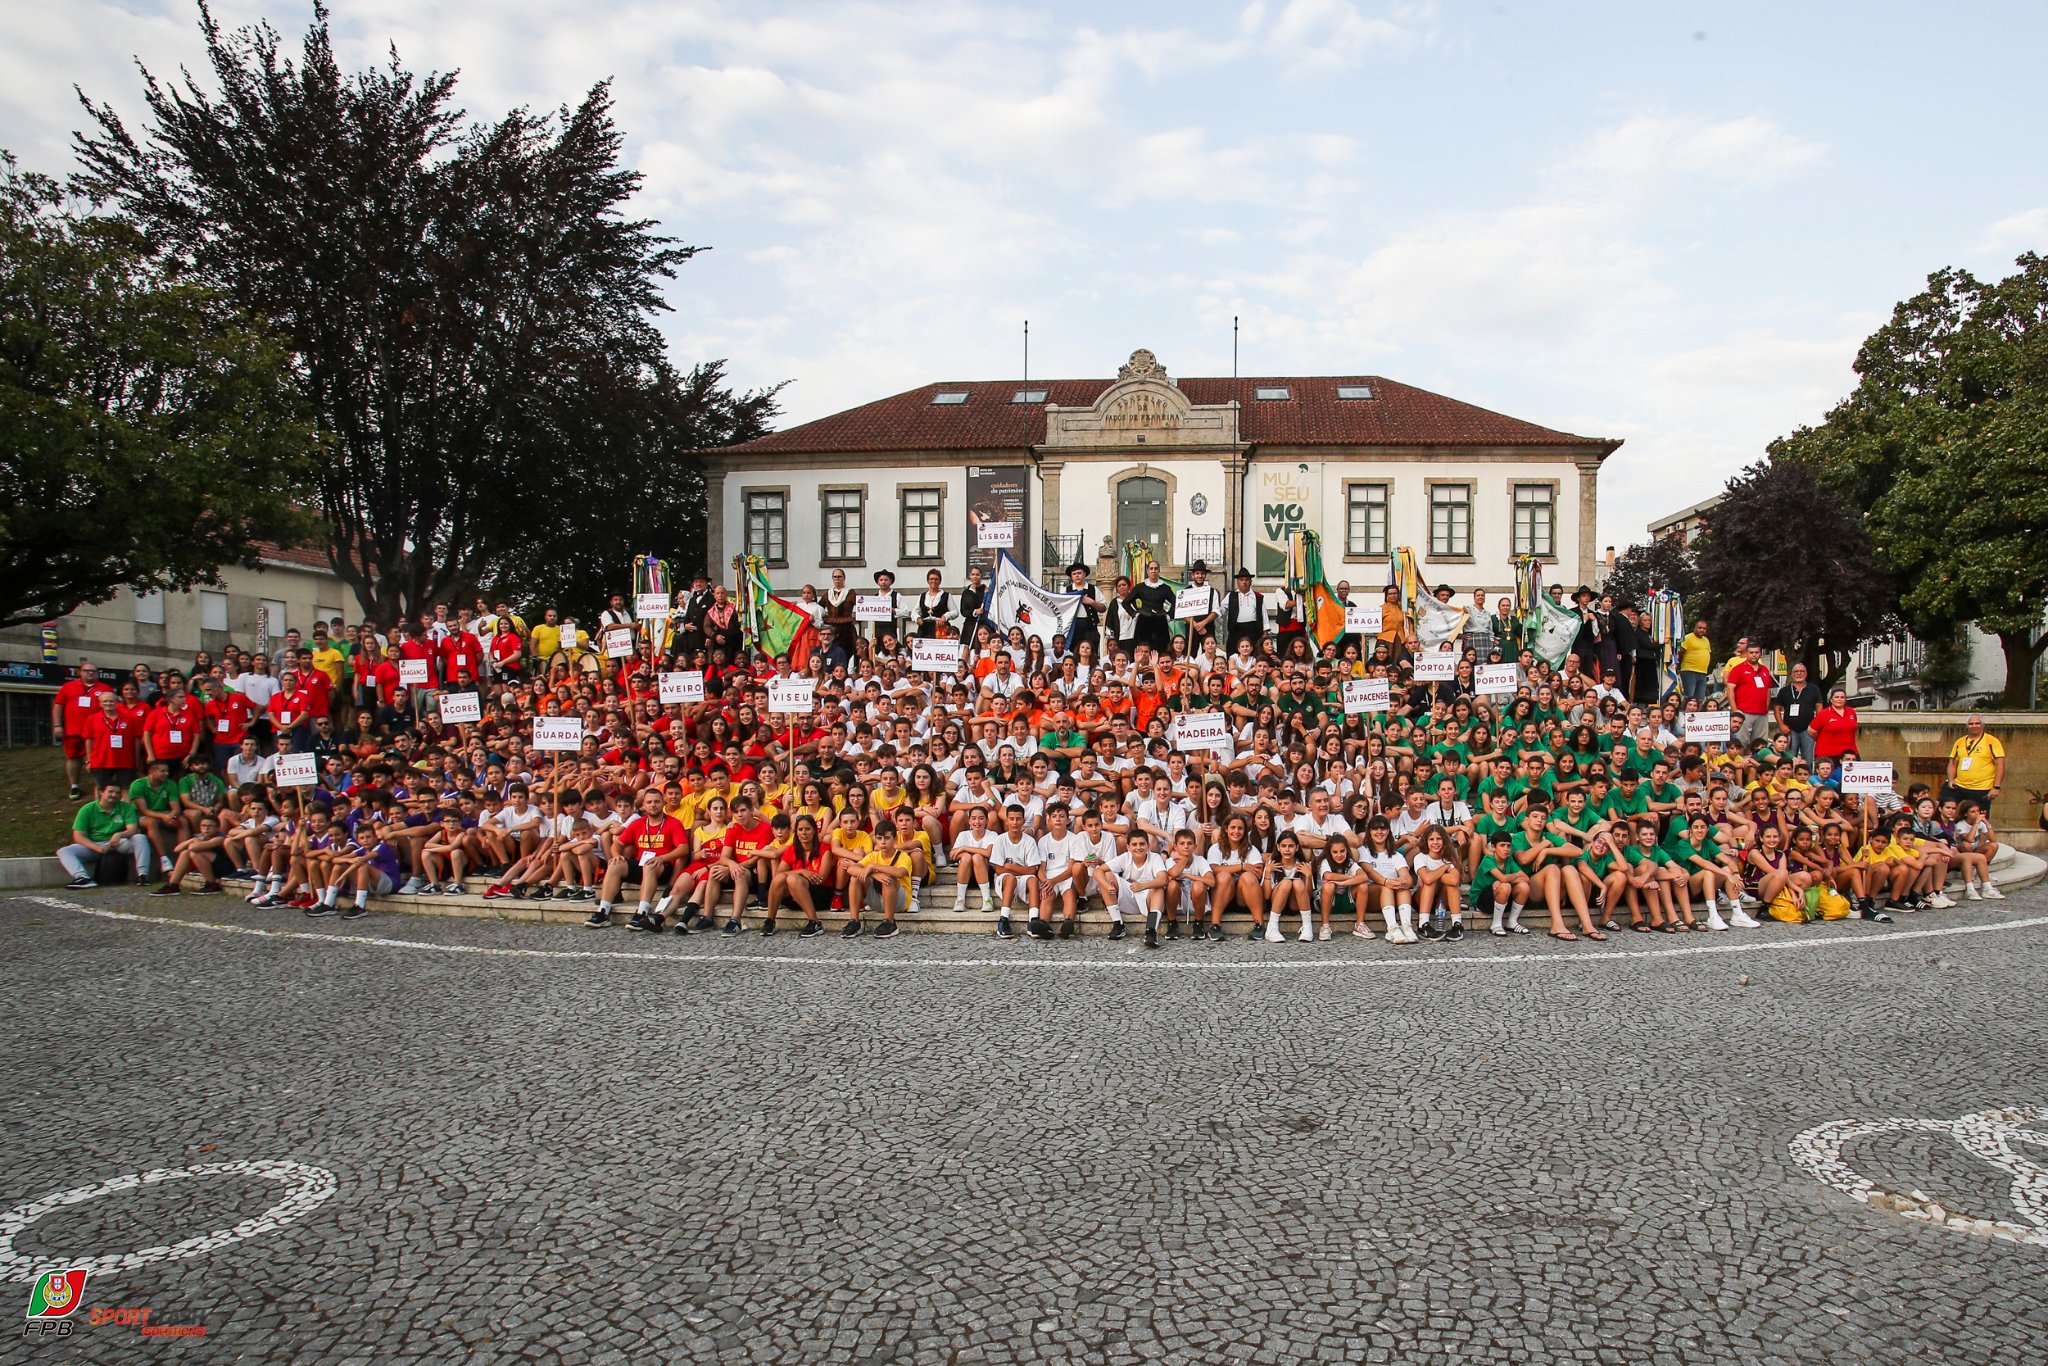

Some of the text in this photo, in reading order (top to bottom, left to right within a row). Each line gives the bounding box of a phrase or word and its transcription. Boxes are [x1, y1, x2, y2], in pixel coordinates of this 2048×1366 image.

[1263, 472, 1290, 487] MU
[1274, 486, 1310, 501] SEU
[979, 533, 1012, 541] LISBOA
[1176, 598, 1209, 609] ALENTEJO
[856, 605, 891, 613] SANTARÉM
[914, 652, 957, 662] VILA REAL
[1415, 664, 1445, 672] PORTO
[1476, 675, 1515, 685] PORTO B
[661, 684, 702, 694] AVEIRO
[772, 693, 809, 702] VISEU
[1345, 691, 1388, 704] JUV PACENSE
[443, 704, 478, 715] AÇORES
[1686, 724, 1729, 732] VIANA CASTELO
[535, 731, 580, 740] GUARDA
[1177, 728, 1224, 740] MADEIRA
[276, 766, 316, 777] SETÚBAL
[1843, 775, 1890, 783] COIMBRA
